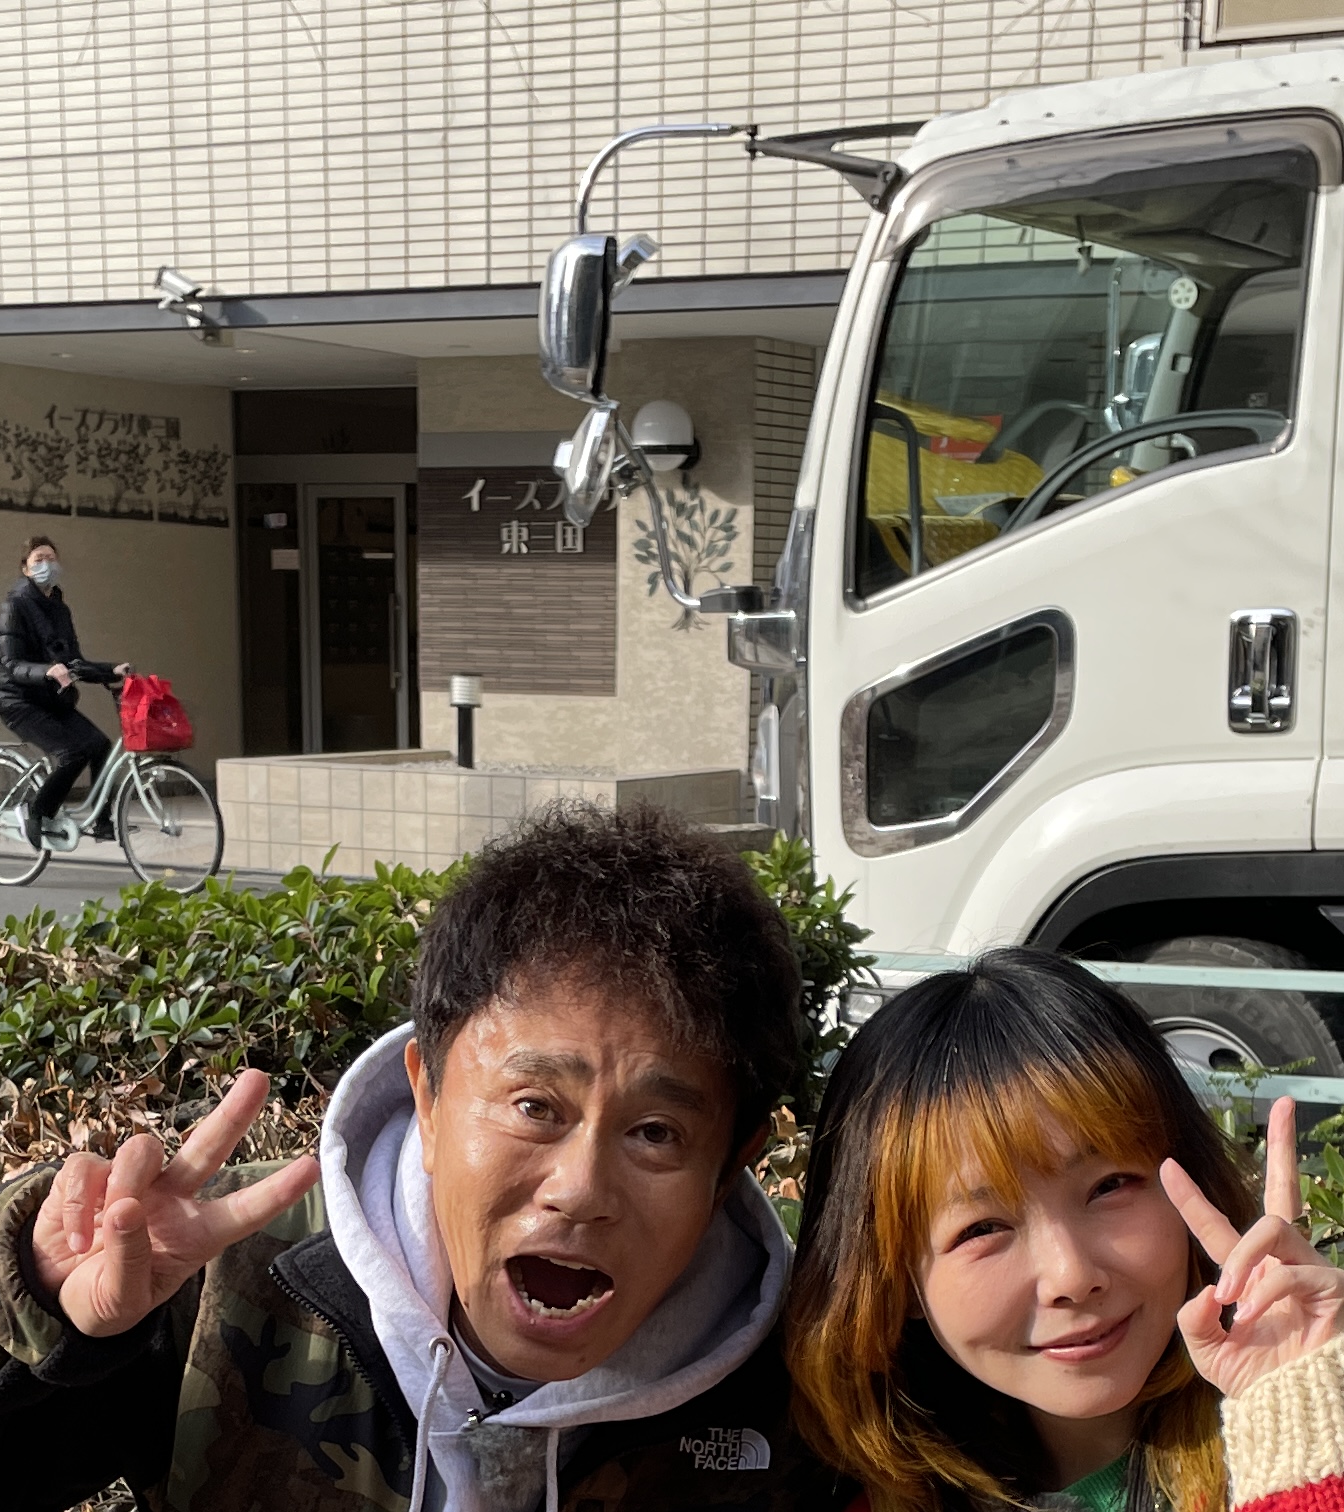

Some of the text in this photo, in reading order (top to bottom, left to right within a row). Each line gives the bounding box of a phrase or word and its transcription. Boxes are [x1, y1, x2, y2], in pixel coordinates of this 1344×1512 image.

[500, 519, 585, 554] 東三国
[707, 1426, 741, 1443] THE
[679, 1436, 740, 1458] NORTH
[694, 1454, 738, 1471] FACE
